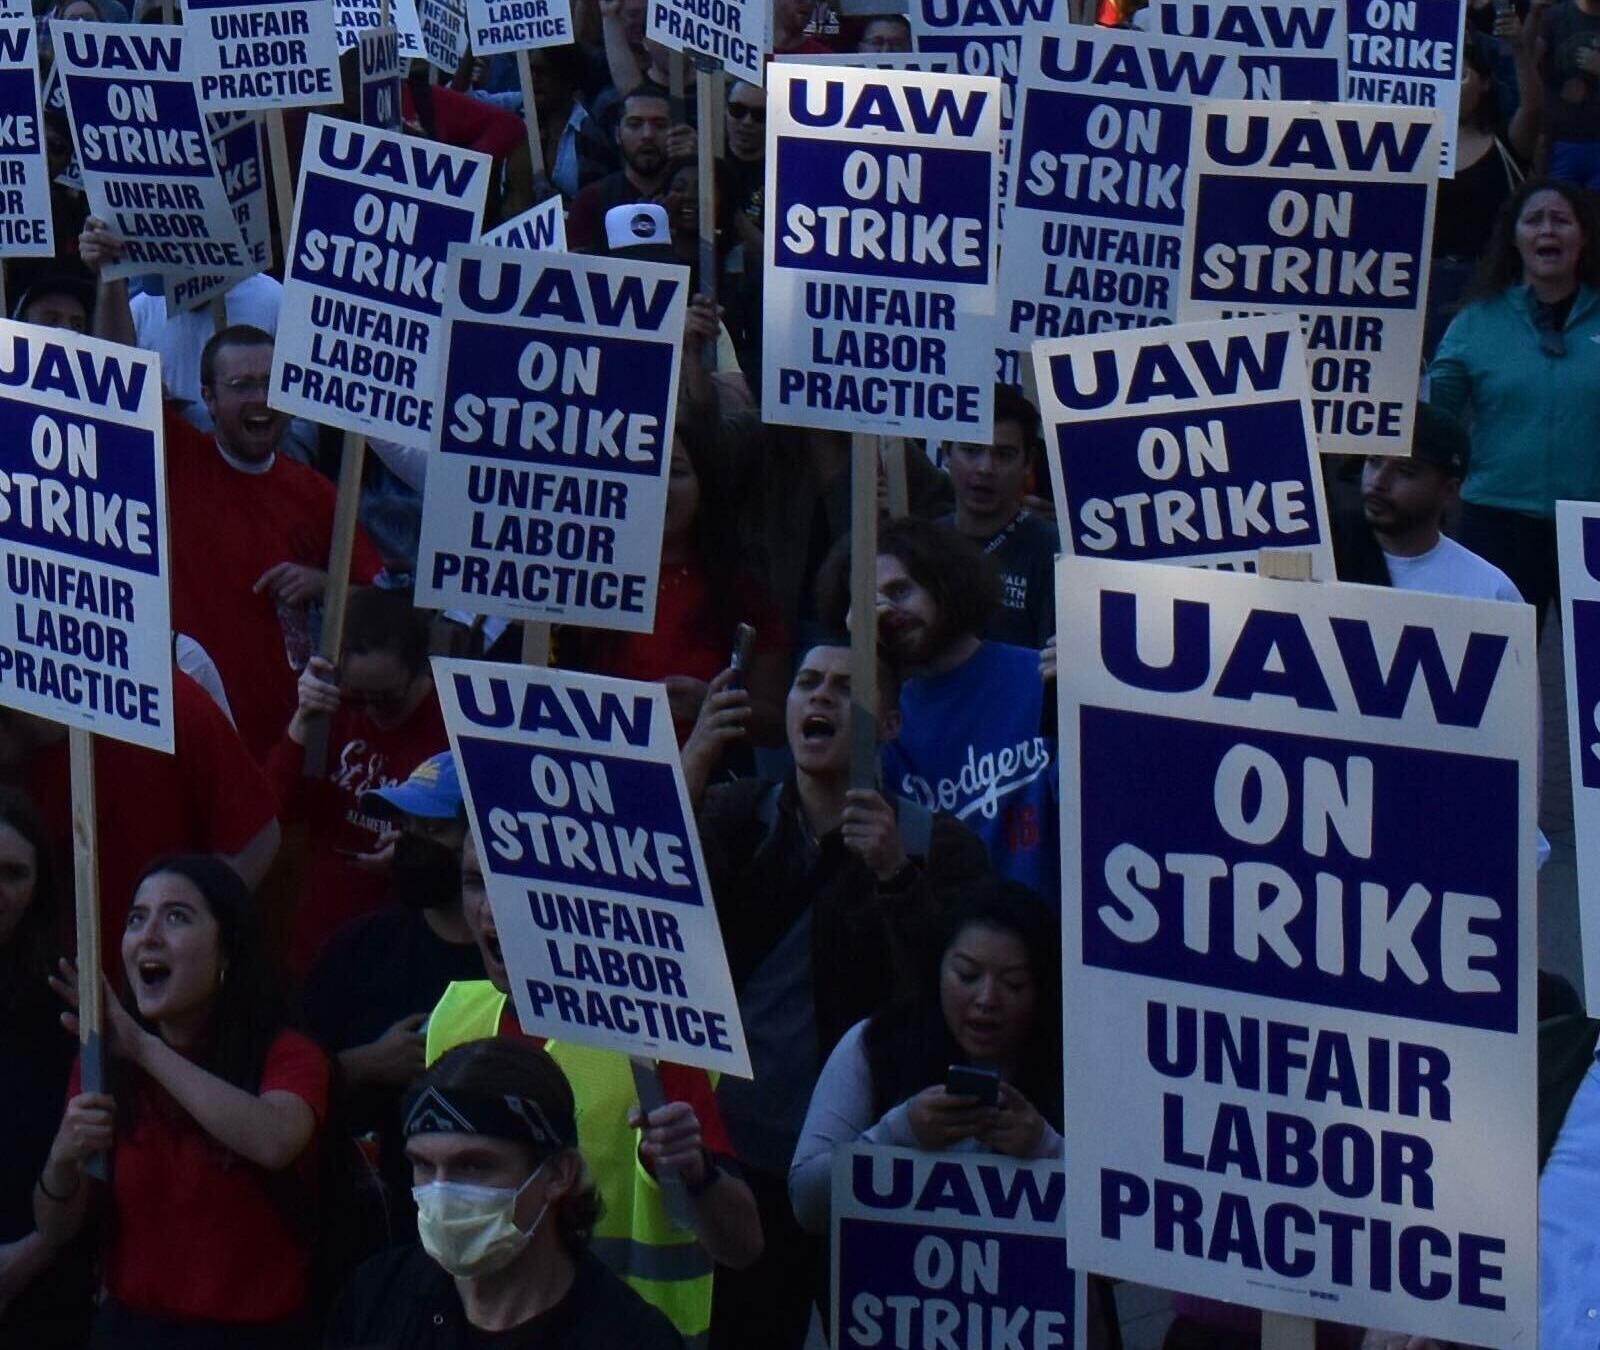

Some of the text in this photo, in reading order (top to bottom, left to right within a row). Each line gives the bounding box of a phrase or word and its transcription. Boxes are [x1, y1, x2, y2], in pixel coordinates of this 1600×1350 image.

[789, 78, 989, 137] UAW
[842, 149, 923, 203] ON
[784, 204, 983, 268] STRIKE
[459, 257, 679, 331] UAW
[806, 281, 954, 330] UNFAIR
[517, 340, 602, 396] ON
[813, 326, 945, 374] LABOR
[450, 393, 659, 463] STRIKE
[780, 368, 979, 422] PRACTICE
[30, 414, 98, 479] ON
[467, 464, 627, 518] UNFAIR
[470, 511, 614, 563] LABOR
[7, 551, 134, 622] UNFAIR
[433, 552, 646, 612] PRACTICE
[16, 601, 128, 670] LABOR
[1101, 591, 1510, 728] UAW
[453, 672, 653, 747] UAW
[530, 754, 616, 814] ON
[902, 736, 1050, 819] Dodgers
[1213, 742, 1375, 859] ON
[490, 807, 694, 886] STRIKE
[527, 888, 683, 951] UNFAIR
[1102, 845, 1504, 995] STRIKE
[546, 937, 687, 997] LABOR
[527, 978, 734, 1051] PRACTICE
[1148, 999, 1447, 1120] UNFAIR
[1164, 1091, 1431, 1209] LABOR
[1102, 1170, 1505, 1311] PRACTICE
